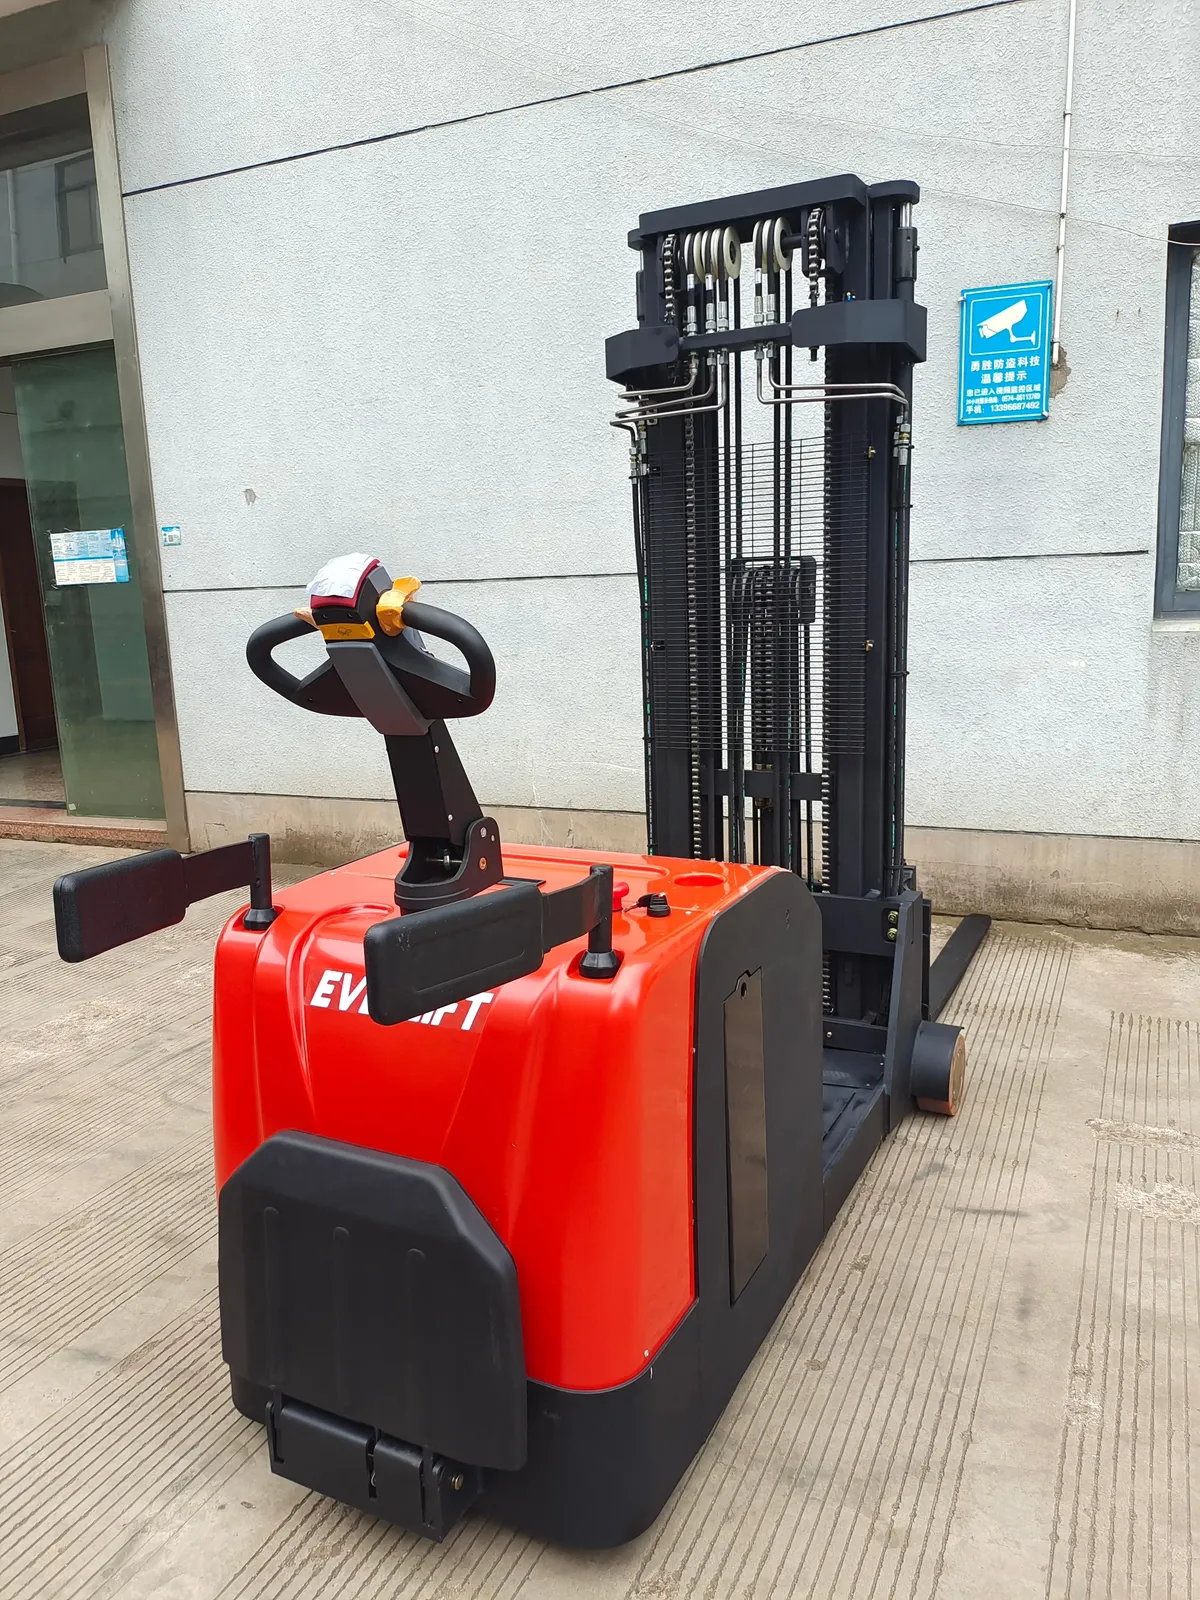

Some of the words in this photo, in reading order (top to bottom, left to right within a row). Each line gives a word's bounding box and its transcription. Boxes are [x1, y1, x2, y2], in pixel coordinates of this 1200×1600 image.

[971, 355, 1040, 372] 勇胜防盗科技
[982, 370, 1027, 384] 温馨提示
[990, 402, 1040, 412] 13396687492
